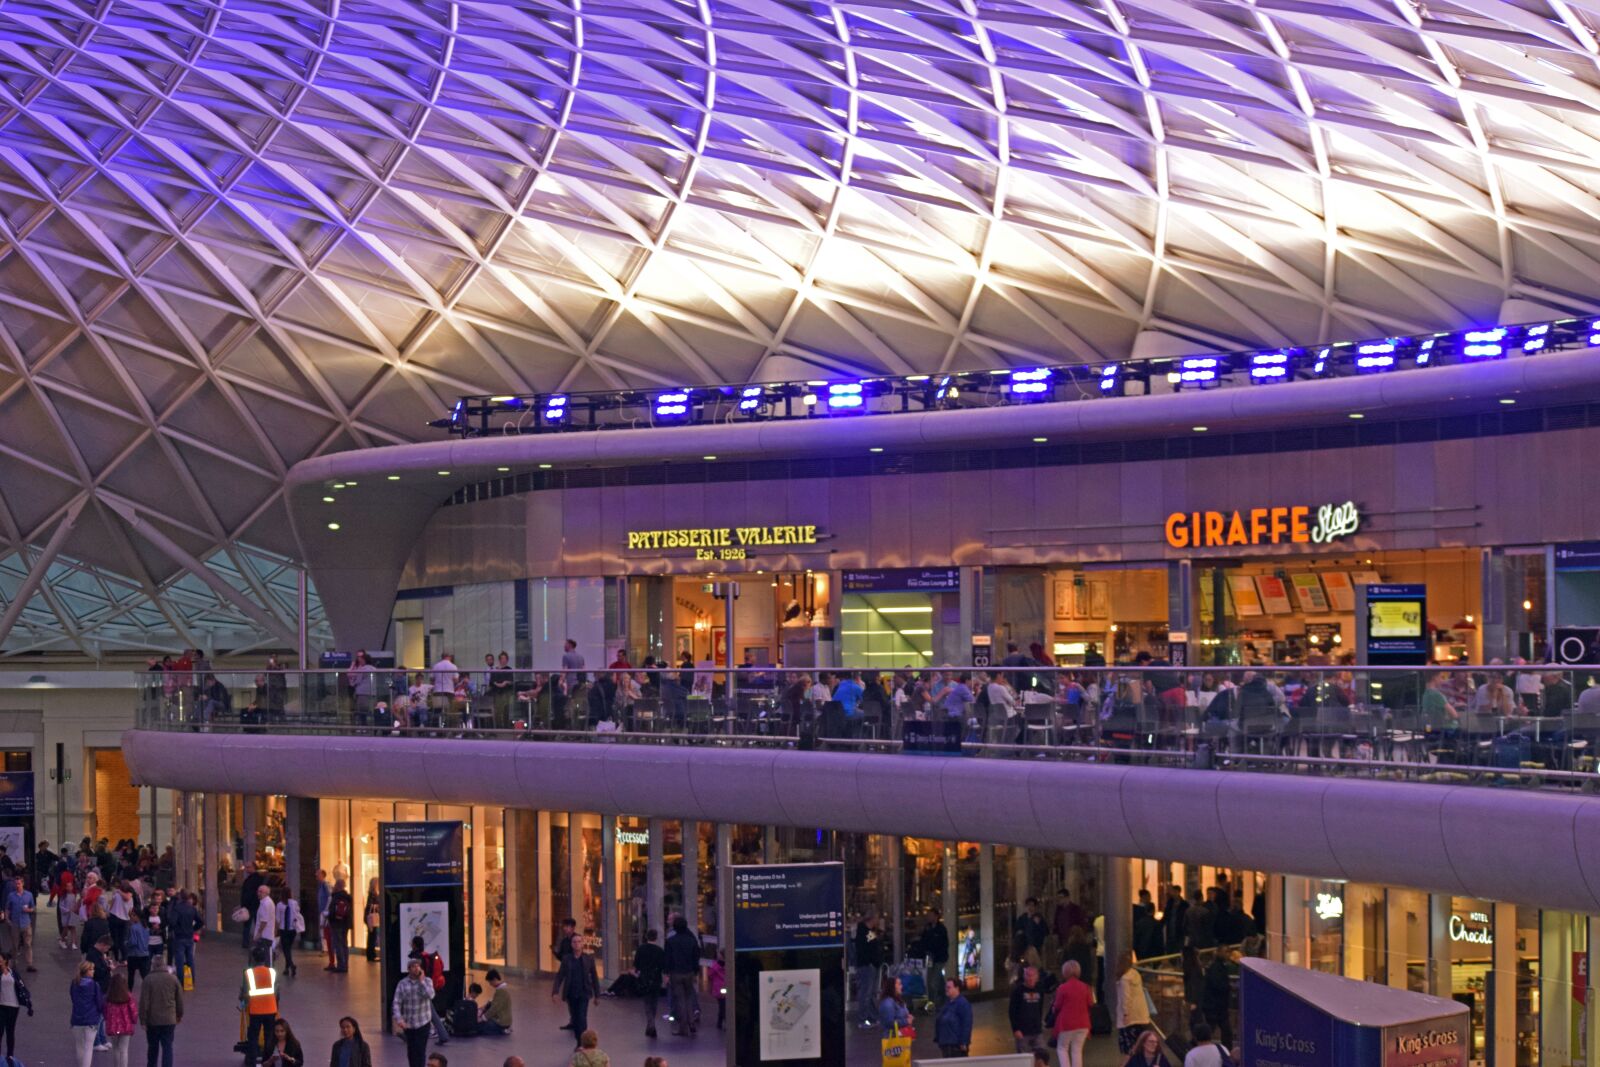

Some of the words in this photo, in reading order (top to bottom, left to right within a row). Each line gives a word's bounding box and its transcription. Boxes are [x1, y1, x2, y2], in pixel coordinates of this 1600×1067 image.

[628, 528, 732, 549] PATISSERIE
[735, 525, 817, 545] VALERIE
[1165, 506, 1310, 549] GIRAFFE
[1311, 501, 1359, 544] Stop
[696, 548, 718, 560] Est.
[719, 548, 746, 560] 1926
[930, 580, 947, 588] Lounge
[1470, 912, 1489, 923] HOTEL
[1255, 1029, 1286, 1052] King's
[1285, 1033, 1316, 1054] Cross
[1399, 1034, 1429, 1055] King's
[1428, 1029, 1458, 1047] Cross
